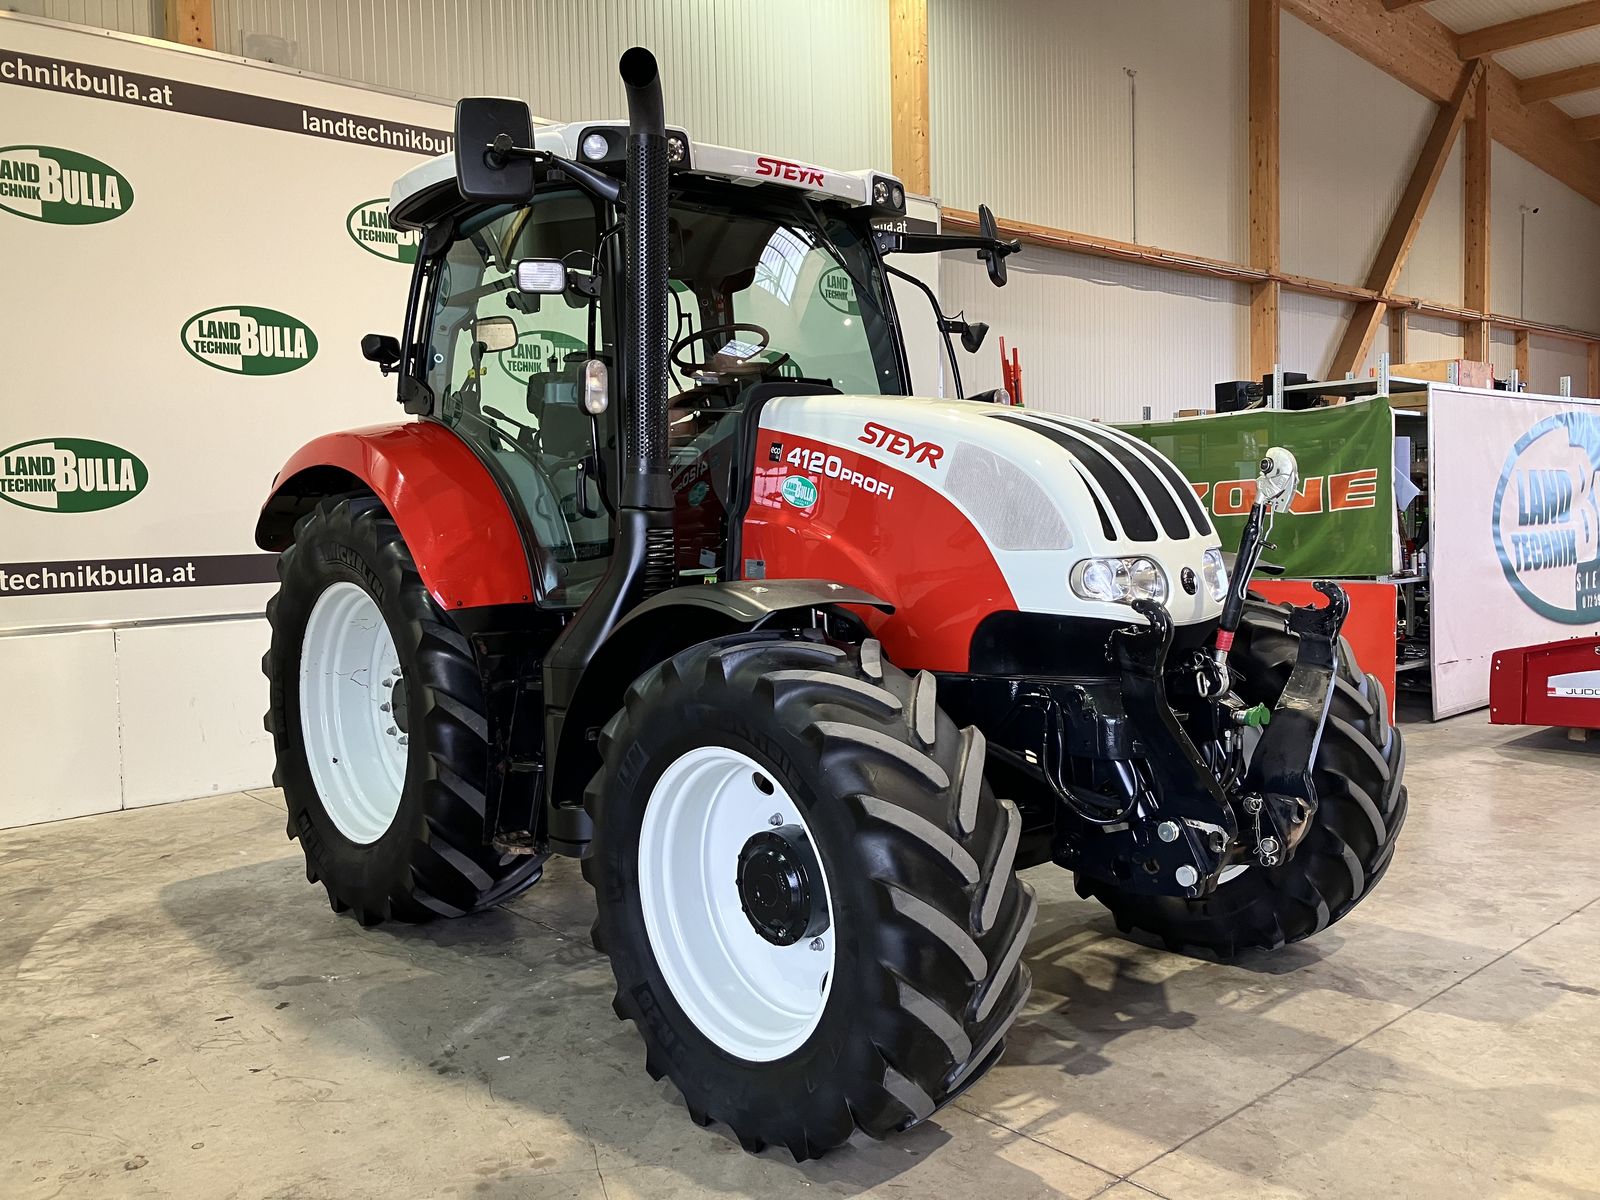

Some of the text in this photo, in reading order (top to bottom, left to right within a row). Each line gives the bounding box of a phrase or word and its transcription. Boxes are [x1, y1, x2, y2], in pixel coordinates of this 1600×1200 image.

[1, 58, 173, 106] chnikbulla.at
[39, 156, 122, 210] BULLA
[756, 157, 824, 187] STEYR
[361, 209, 390, 229] LAN
[357, 228, 398, 244] TECHNIK
[827, 274, 848, 289] LAND
[198, 319, 240, 340] LAND
[240, 316, 308, 359] BULLA
[193, 340, 242, 355] TECHNIK
[511, 343, 541, 360] LAND
[507, 360, 541, 373] TECHNIK
[857, 421, 944, 470] STEYR
[5, 456, 56, 476] LAND
[55, 449, 137, 492] BULLA
[786, 447, 895, 500] 4120 PROFI
[0, 478, 57, 492] TECHNIK
[1515, 469, 1572, 526] LAND
[1511, 528, 1577, 573] TECHNIK
[0, 562, 196, 591] technikbulla.at
